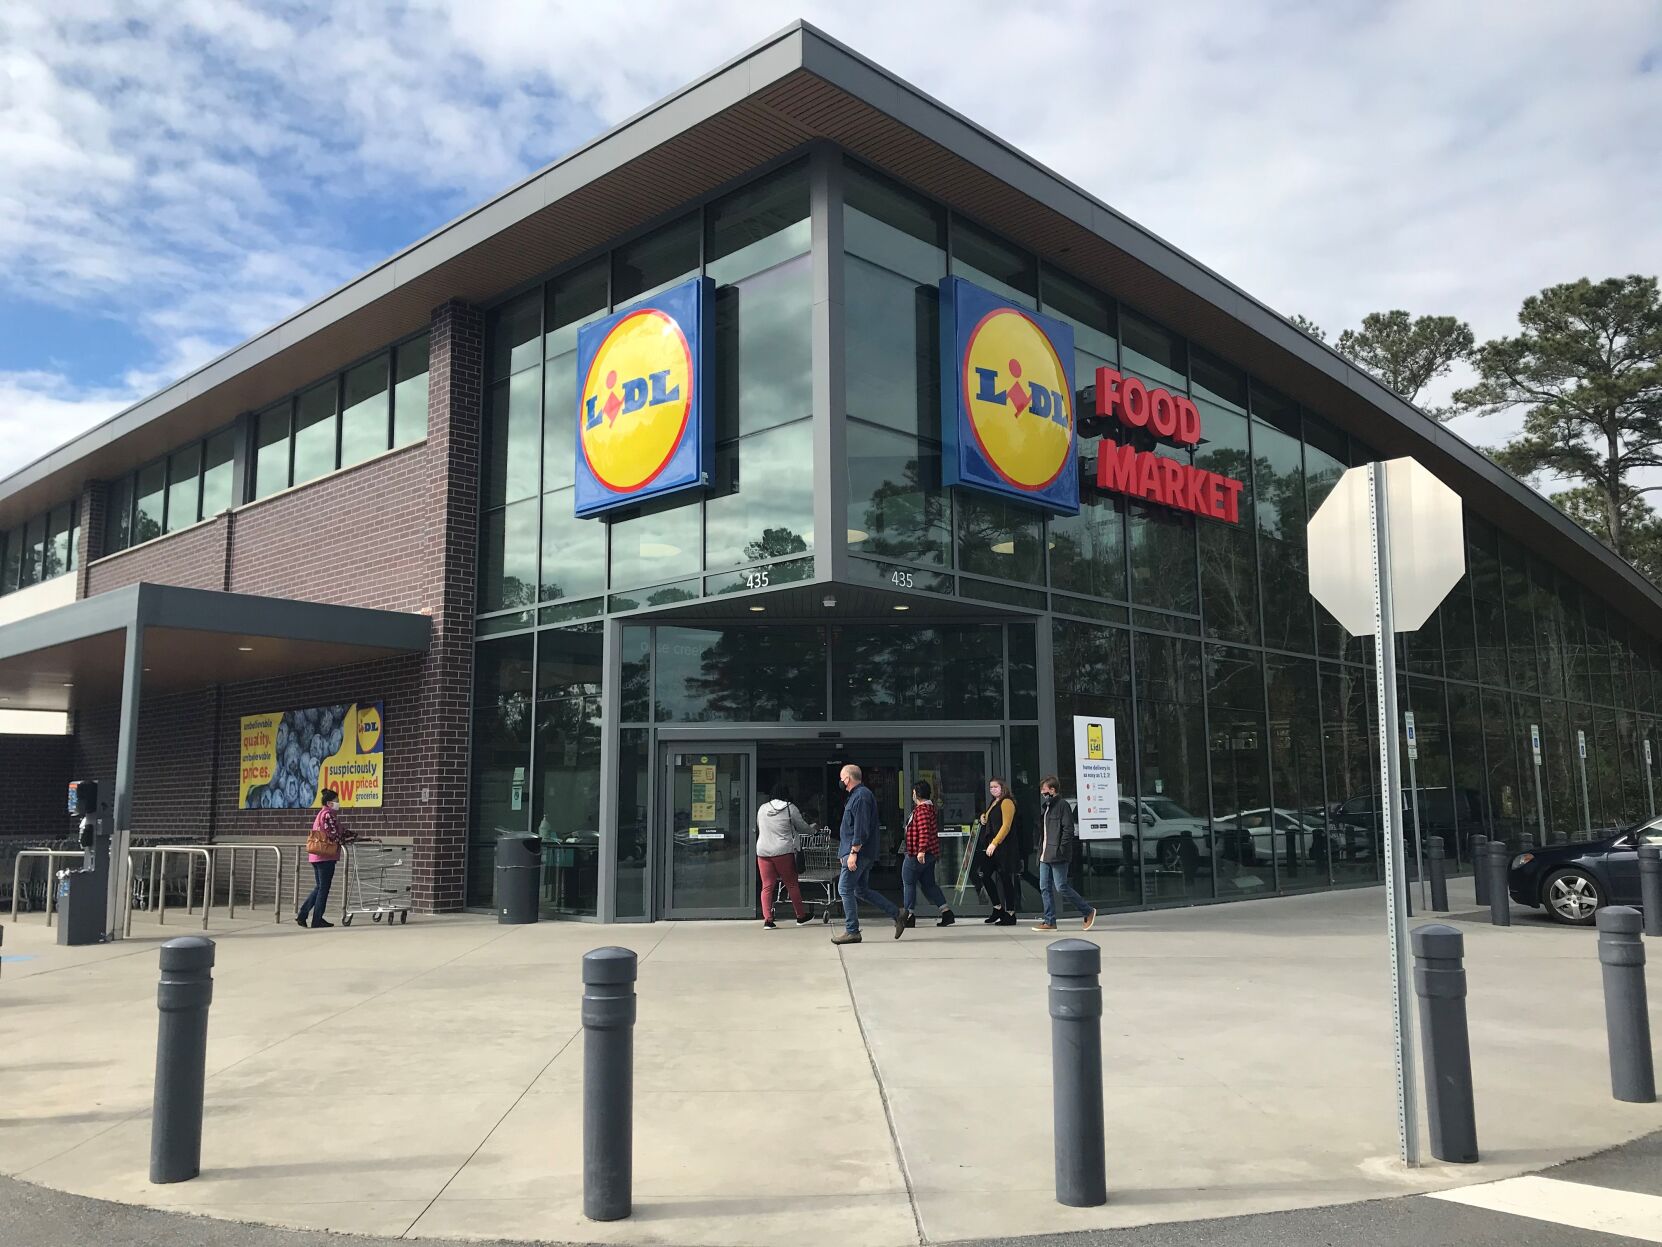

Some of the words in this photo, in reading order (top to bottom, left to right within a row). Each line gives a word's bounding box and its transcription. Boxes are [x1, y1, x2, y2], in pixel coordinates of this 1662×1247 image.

[1096, 366, 1201, 445] FOOD
[1097, 438, 1244, 525] MARKET
[746, 572, 769, 589] 435
[892, 571, 913, 588] 435
[243, 719, 273, 731] unbelievable
[243, 732, 271, 750] quality.
[243, 752, 272, 763] unbelievable
[243, 763, 271, 783] prices.
[329, 761, 377, 778] suspiciously
[355, 776, 379, 790] priced
[355, 792, 379, 801] groceries
